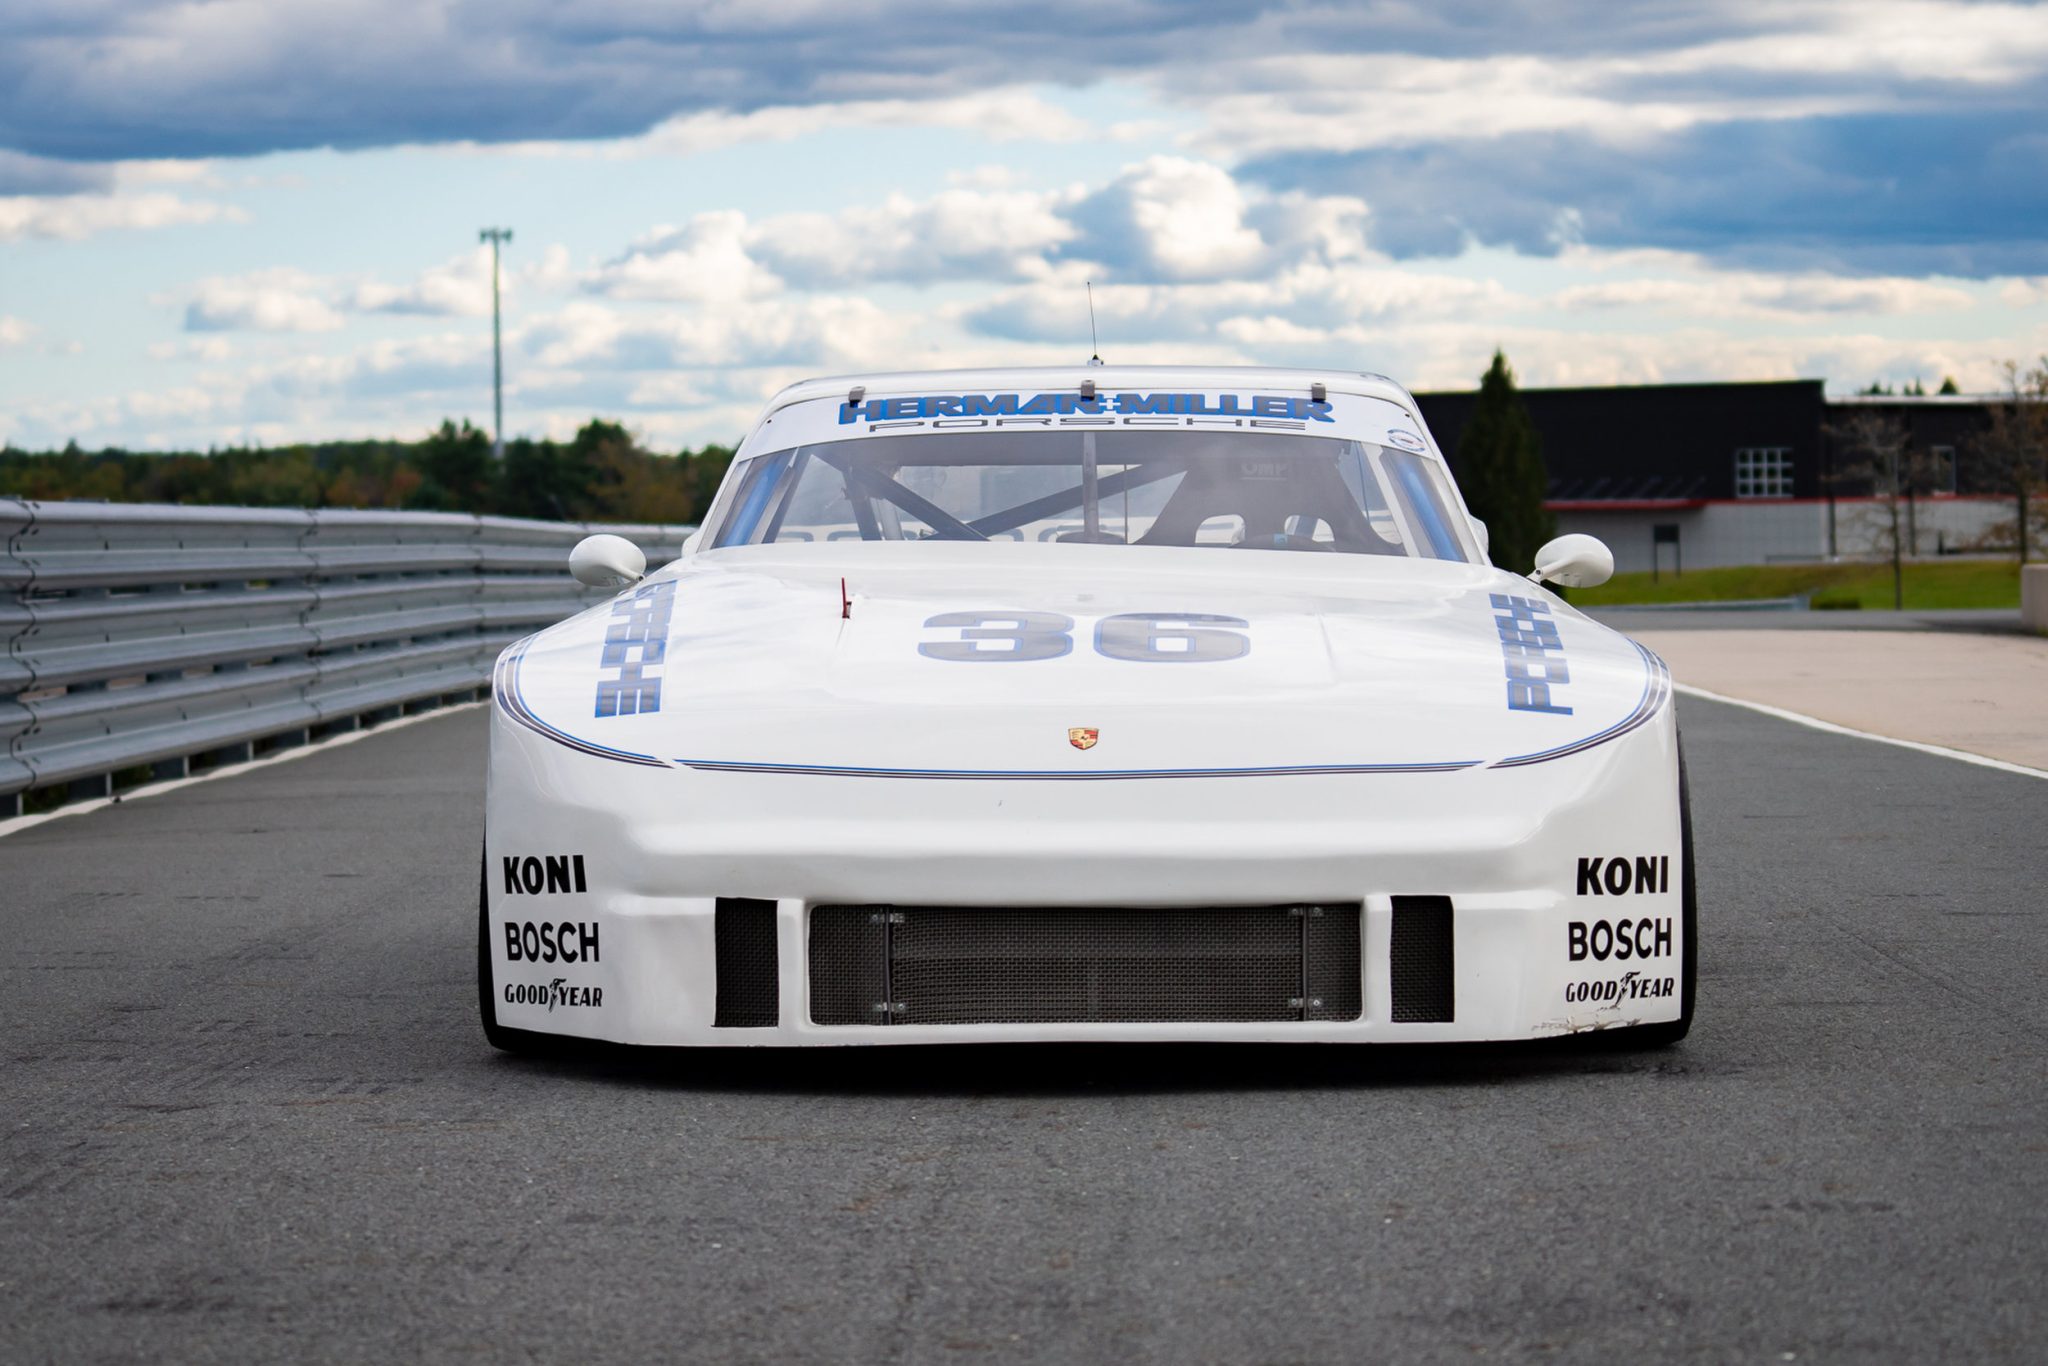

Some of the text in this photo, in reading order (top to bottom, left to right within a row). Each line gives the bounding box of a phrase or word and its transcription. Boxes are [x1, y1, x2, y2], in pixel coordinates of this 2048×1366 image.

[869, 417, 1306, 432] PORSCHE
[917, 610, 1251, 663] 36
[503, 854, 587, 895] KONI
[1577, 855, 1669, 896] KONI
[504, 921, 600, 963] BOSCH
[1568, 917, 1672, 961] BOSCH
